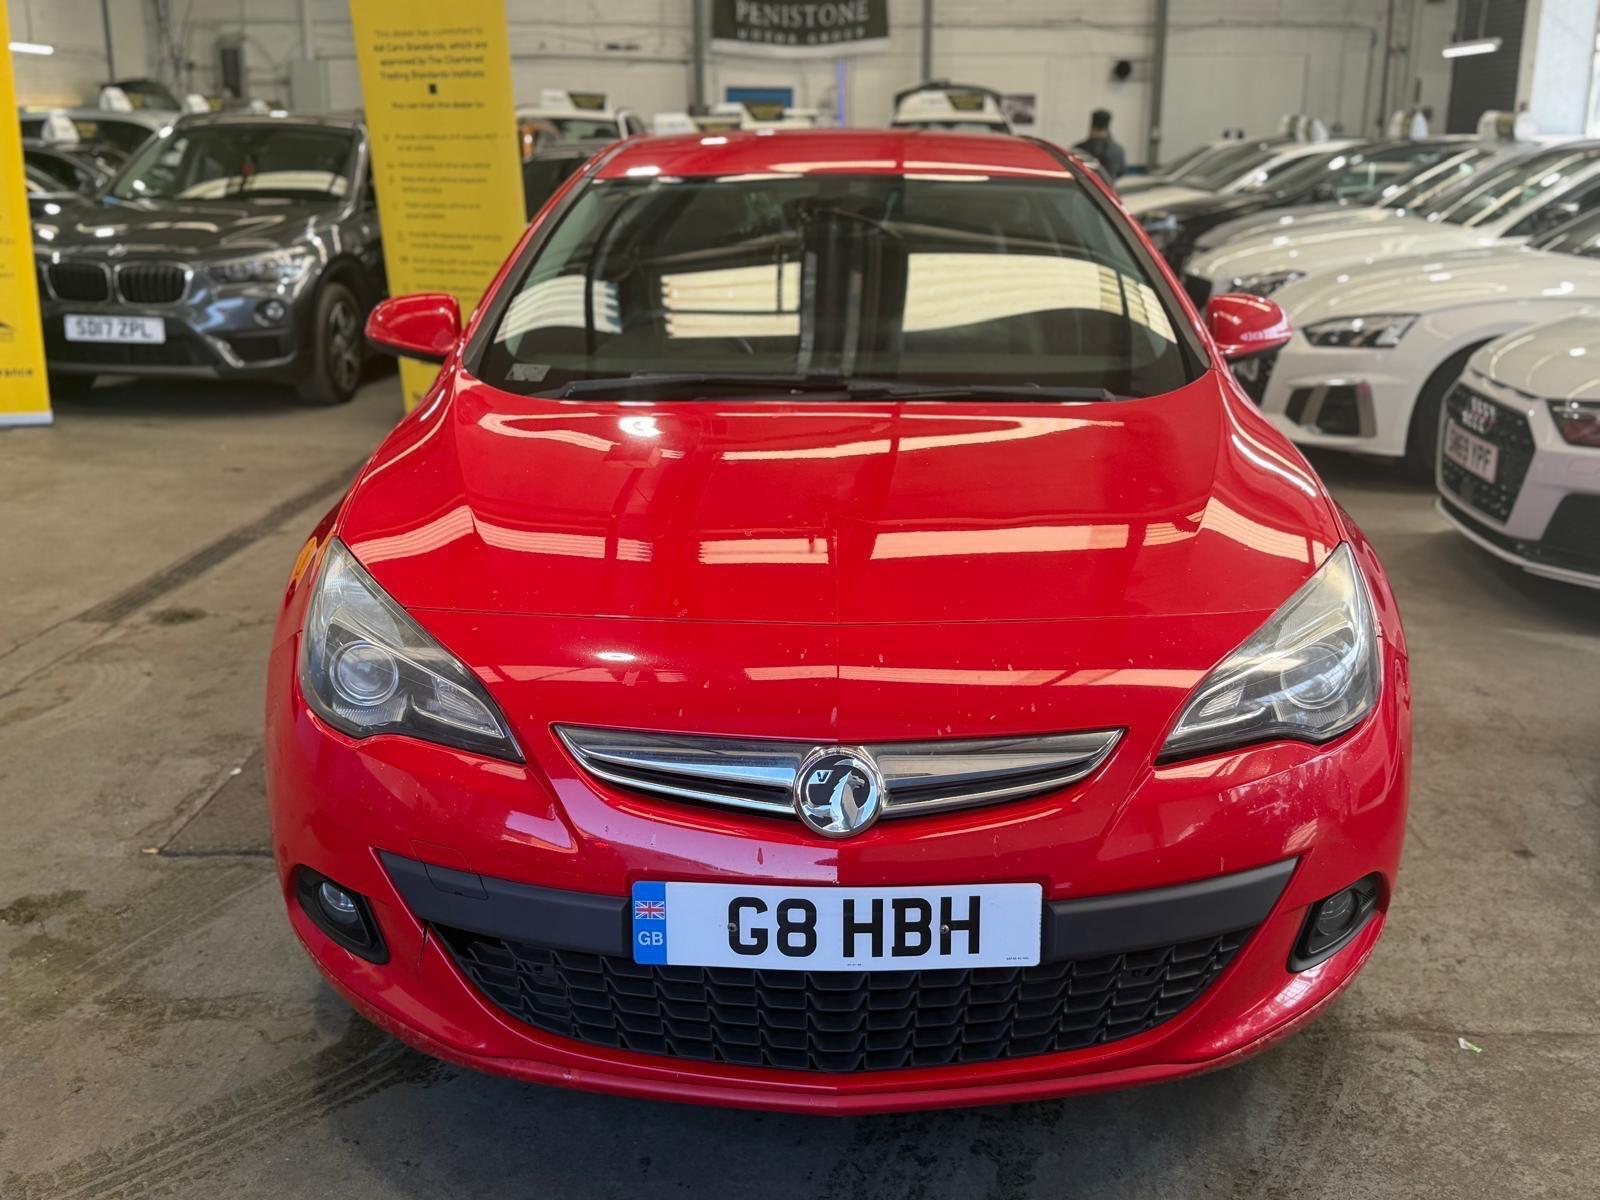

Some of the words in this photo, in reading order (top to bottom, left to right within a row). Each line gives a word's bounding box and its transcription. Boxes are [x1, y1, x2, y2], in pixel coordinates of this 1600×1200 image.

[736, 1, 870, 28] PENISTONE
[120, 321, 153, 339] ZPL
[728, 896, 817, 957] G8
[843, 896, 981, 958] HBH
[637, 931, 664, 946] GB
